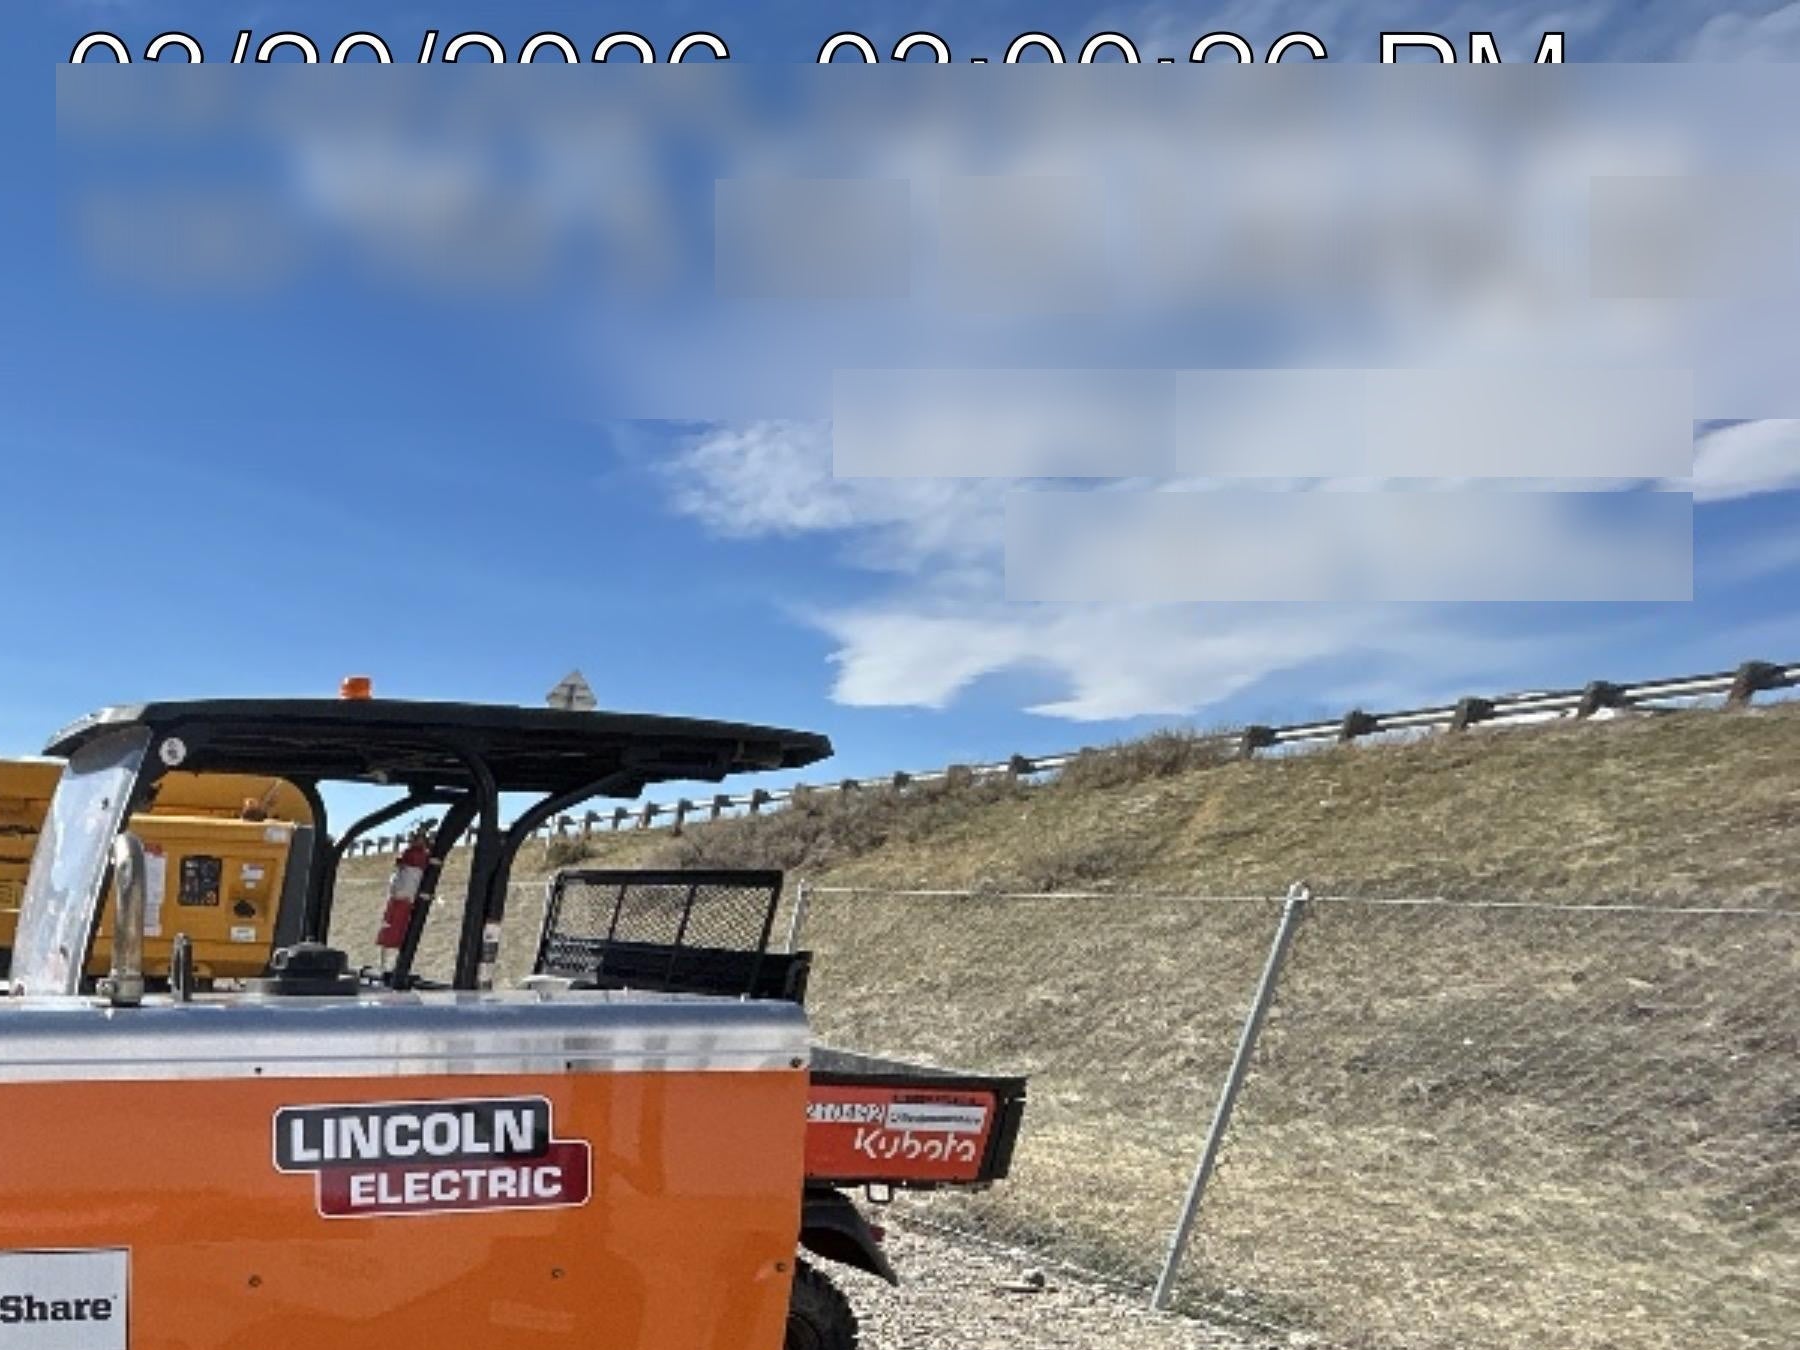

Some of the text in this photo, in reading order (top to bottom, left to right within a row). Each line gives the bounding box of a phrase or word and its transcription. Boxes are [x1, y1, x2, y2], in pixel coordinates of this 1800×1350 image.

[291, 1109, 535, 1162] LINCOLN
[854, 1126, 976, 1162] Kubota
[350, 1166, 563, 1206] ELECTRIC
